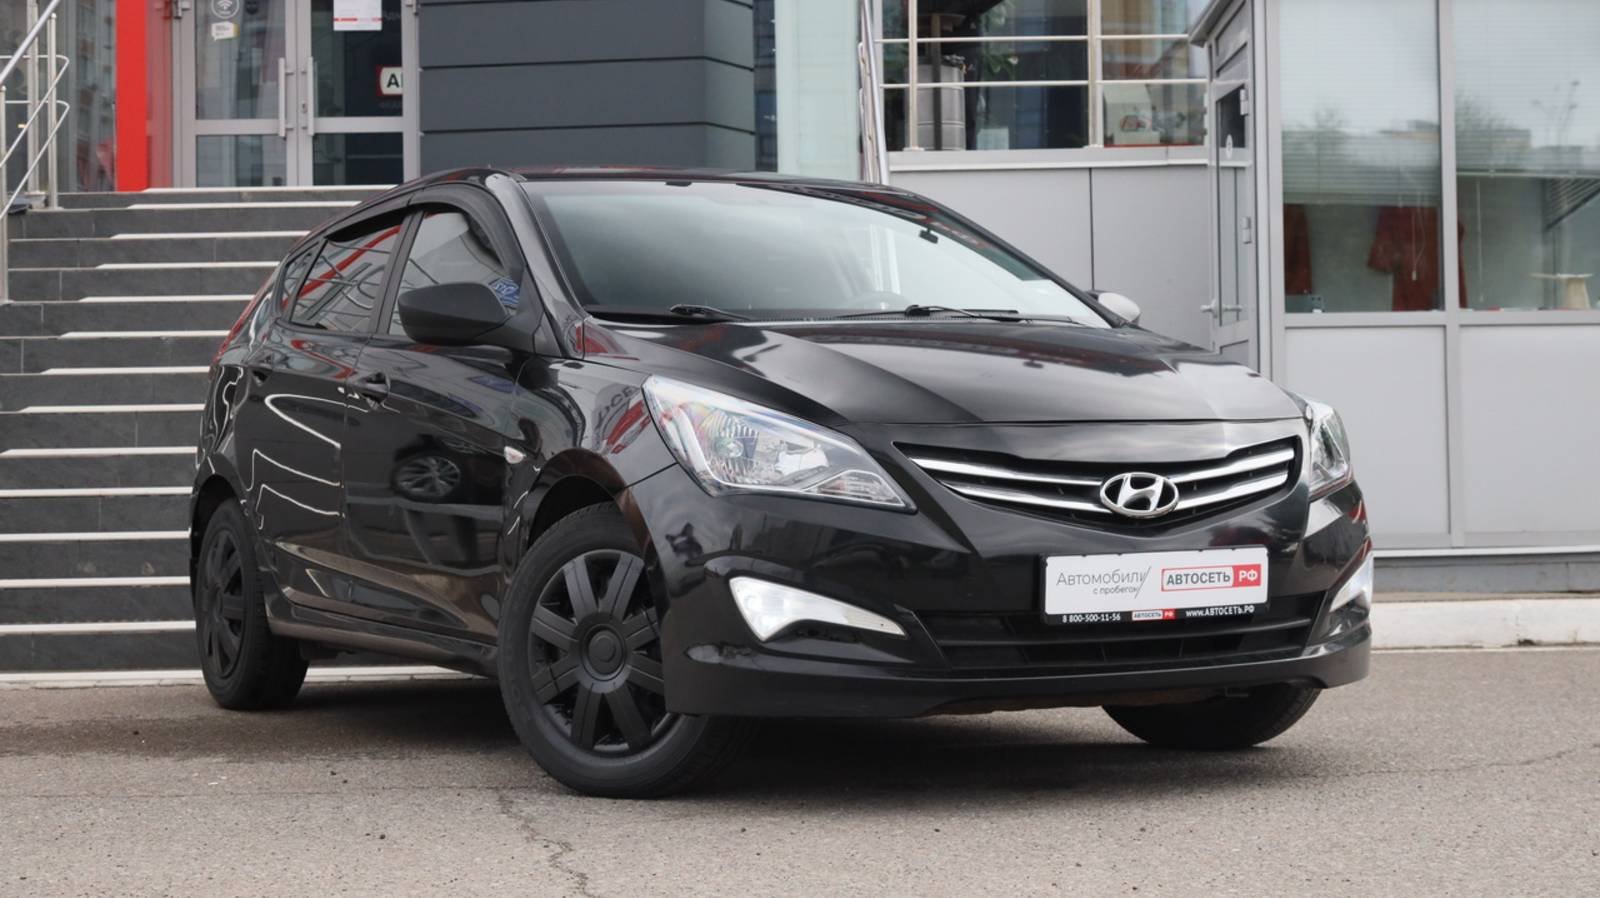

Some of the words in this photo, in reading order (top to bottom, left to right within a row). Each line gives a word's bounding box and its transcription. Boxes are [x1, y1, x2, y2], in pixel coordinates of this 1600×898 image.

[386, 73, 403, 88] А
[1166, 571, 1231, 585] АВТОСЕТЬ
[1238, 569, 1258, 582] РФ
[1062, 615, 1067, 623] 8
[1069, 613, 1121, 622] 800-500-11-56
